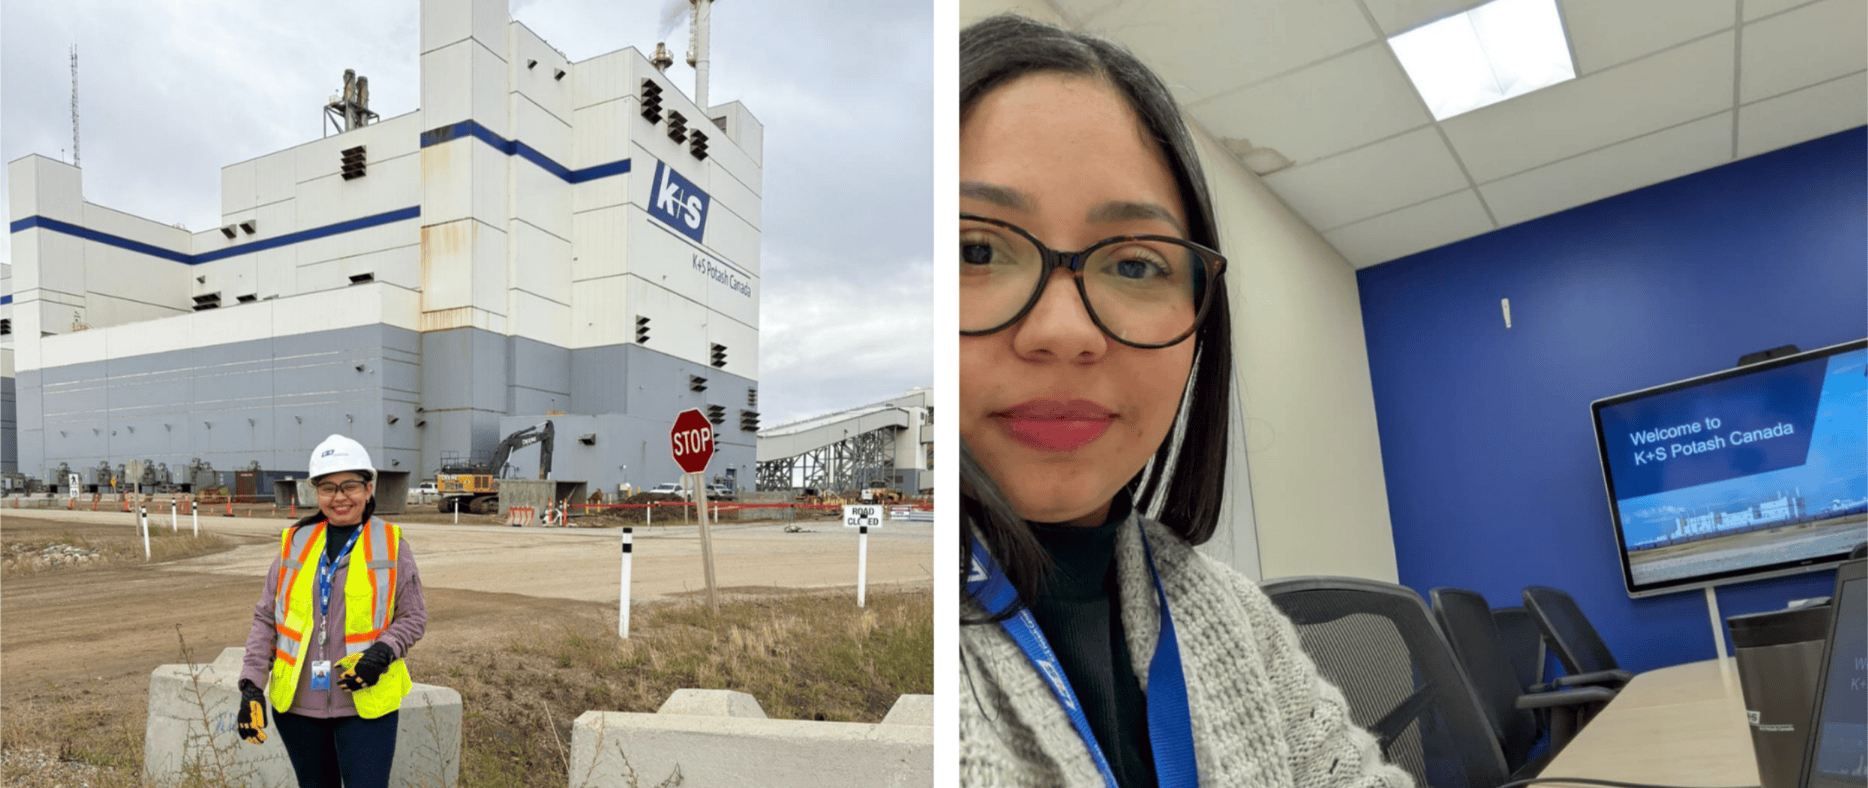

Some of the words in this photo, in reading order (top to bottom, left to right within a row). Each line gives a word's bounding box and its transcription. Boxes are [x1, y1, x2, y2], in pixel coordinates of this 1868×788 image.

[692, 253, 706, 275] K+S
[706, 260, 728, 287] Potash
[729, 274, 752, 299] Canada
[673, 427, 711, 457] STOP
[1629, 421, 1702, 446] Welcome
[1704, 416, 1722, 431] to
[1633, 446, 1668, 466] K+S
[1670, 435, 1727, 459] Potash
[1729, 421, 1795, 446] Canada
[847, 517, 879, 526] CLED
[852, 507, 875, 516] ROAD
